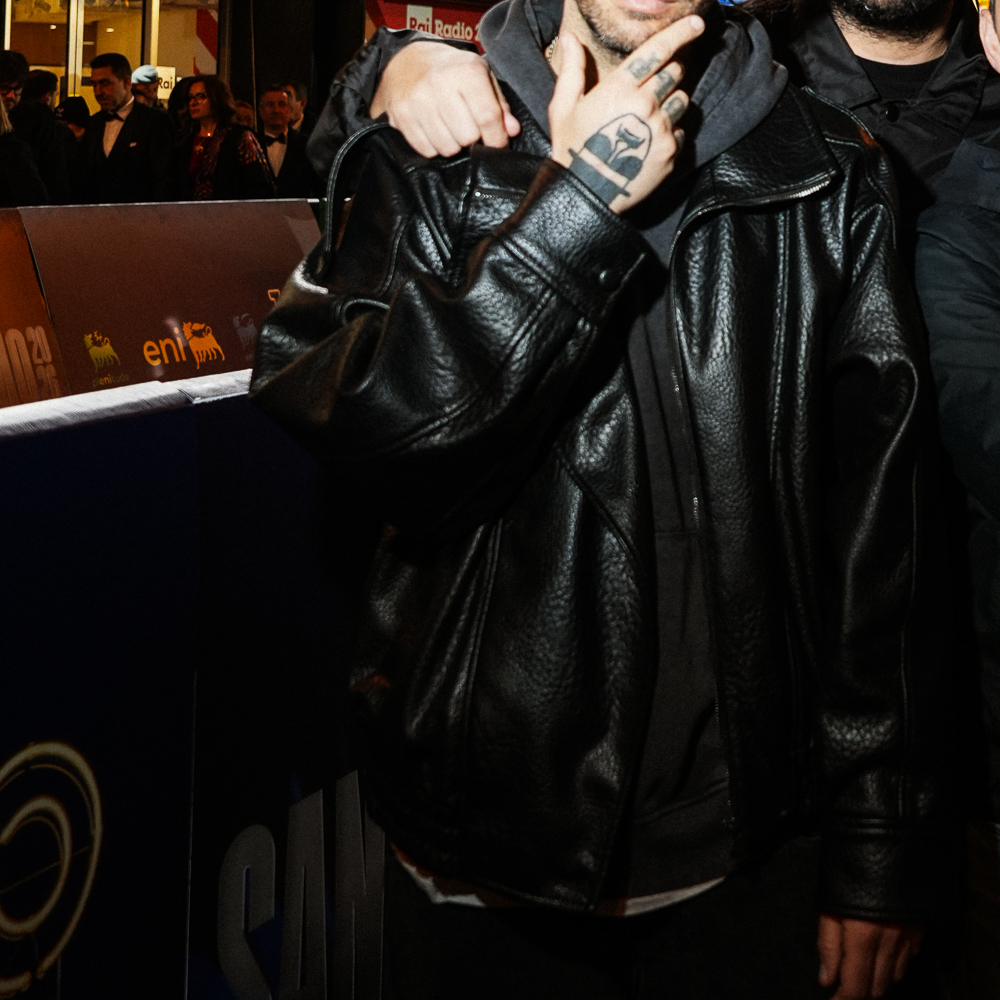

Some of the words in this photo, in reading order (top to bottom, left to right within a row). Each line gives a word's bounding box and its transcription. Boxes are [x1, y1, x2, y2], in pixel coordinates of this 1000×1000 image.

[409, 16, 430, 32] Rai
[435, 19, 474, 41] Radio
[143, 326, 187, 367] eni
